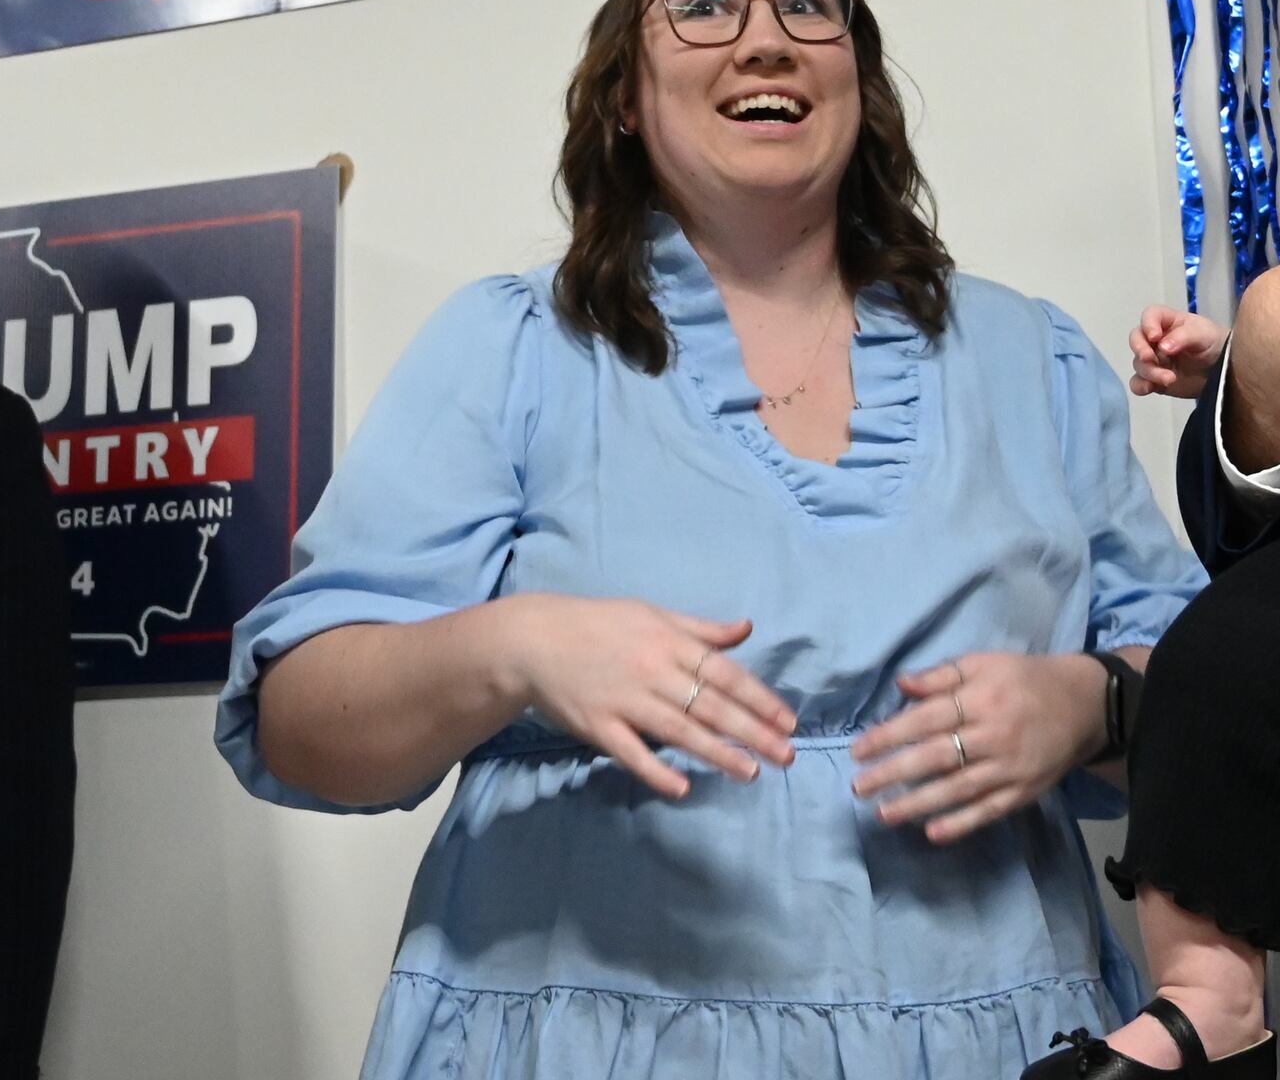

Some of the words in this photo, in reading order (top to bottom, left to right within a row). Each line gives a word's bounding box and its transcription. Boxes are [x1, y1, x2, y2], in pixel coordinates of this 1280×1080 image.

[43, 426, 219, 486] NTRY
[56, 503, 136, 529] GREAT
[144, 496, 233, 523] AGAIN!
